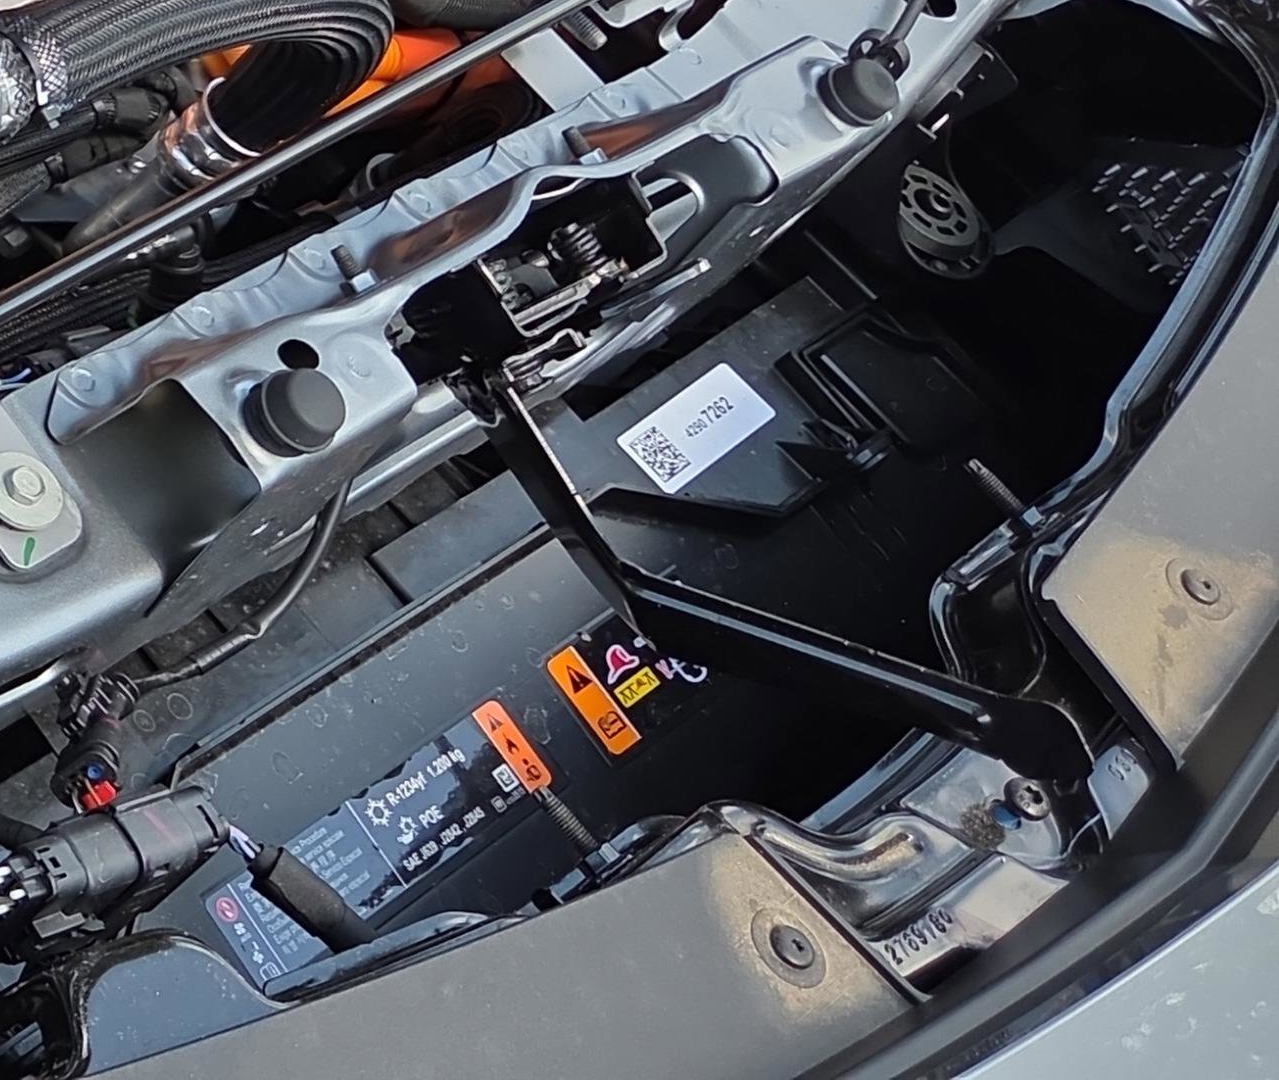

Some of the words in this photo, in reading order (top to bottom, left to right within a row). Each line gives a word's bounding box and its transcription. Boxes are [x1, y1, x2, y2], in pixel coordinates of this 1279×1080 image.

[700, 396, 734, 424] 7262
[385, 771, 427, 807] R-1234yf
[427, 754, 453, 777] 1.200
[447, 748, 466, 763] kg
[418, 805, 445, 829] POE
[403, 852, 423, 872] SAE
